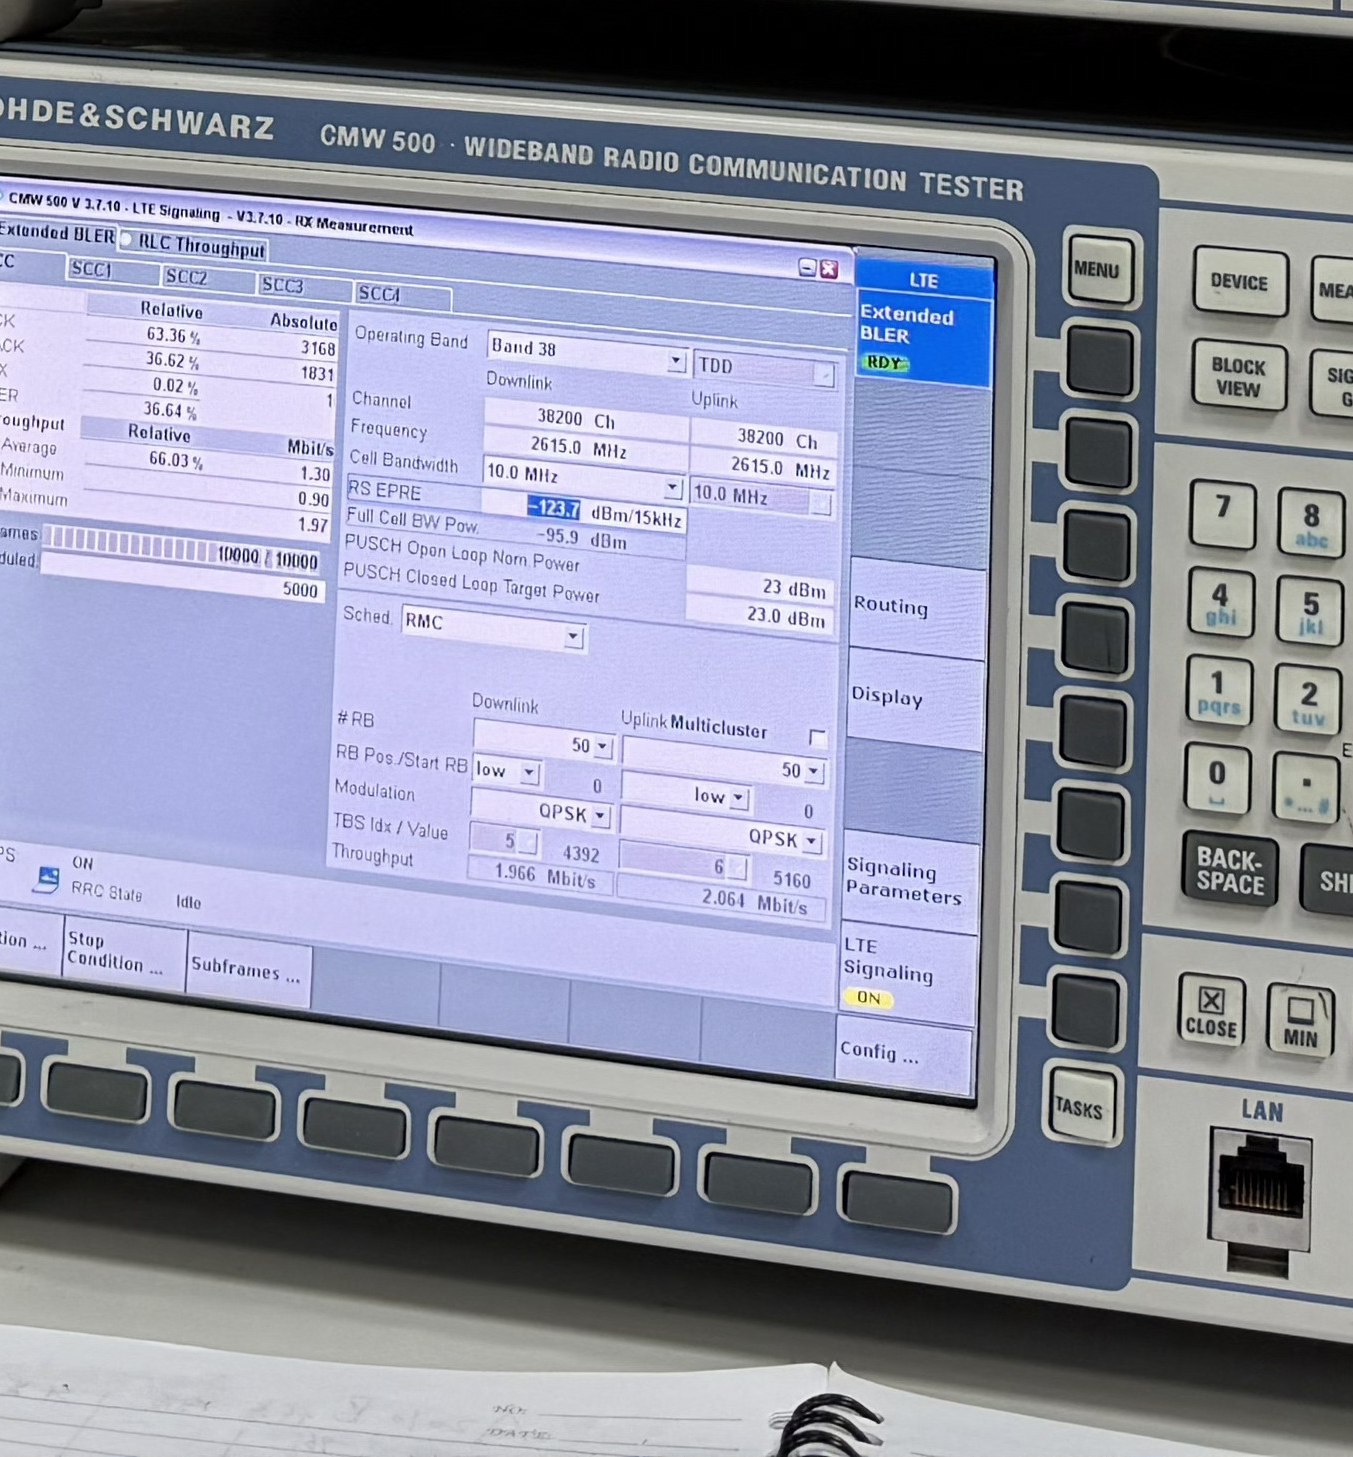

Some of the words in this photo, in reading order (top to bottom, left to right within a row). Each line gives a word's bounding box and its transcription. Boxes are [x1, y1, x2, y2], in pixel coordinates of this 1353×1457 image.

[320, 123, 387, 149] CMW
[392, 130, 436, 154] 500
[464, 135, 594, 166] WIDEBAND
[603, 146, 679, 173] RADIO
[688, 153, 907, 192] COMMUNICATION
[919, 171, 1024, 202] TESTER
[73, 226, 116, 245] BLER
[71, 259, 112, 279] SCC1
[166, 267, 208, 286] SCC2
[1074, 259, 1120, 280] MENU
[909, 271, 939, 289] LTE
[1211, 271, 1269, 292] DEVICE
[860, 303, 954, 326] Extended
[860, 324, 910, 345] BLER
[301, 339, 336, 357] 3168
[699, 356, 733, 374] TDD
[867, 354, 902, 370] RDY
[1211, 356, 1266, 377] BLOCK
[1216, 379, 1261, 399] VIEW
[283, 580, 319, 599] 5000
[854, 595, 929, 621] Routing
[405, 612, 443, 631] RMC
[852, 685, 923, 711] Display
[670, 713, 768, 740] Multicluster
[1197, 845, 1263, 872] BACK-
[847, 856, 937, 885] Signaling
[846, 878, 962, 906] Parameters
[1197, 869, 1265, 896] SPACE
[844, 936, 878, 955] LTE
[844, 959, 934, 988] Signaling
[857, 990, 881, 1005] ON
[1185, 1016, 1237, 1039] CLOSE
[1283, 1028, 1318, 1049] MIN
[1055, 1095, 1103, 1121] TASKS
[1242, 1098, 1284, 1123] LAN
